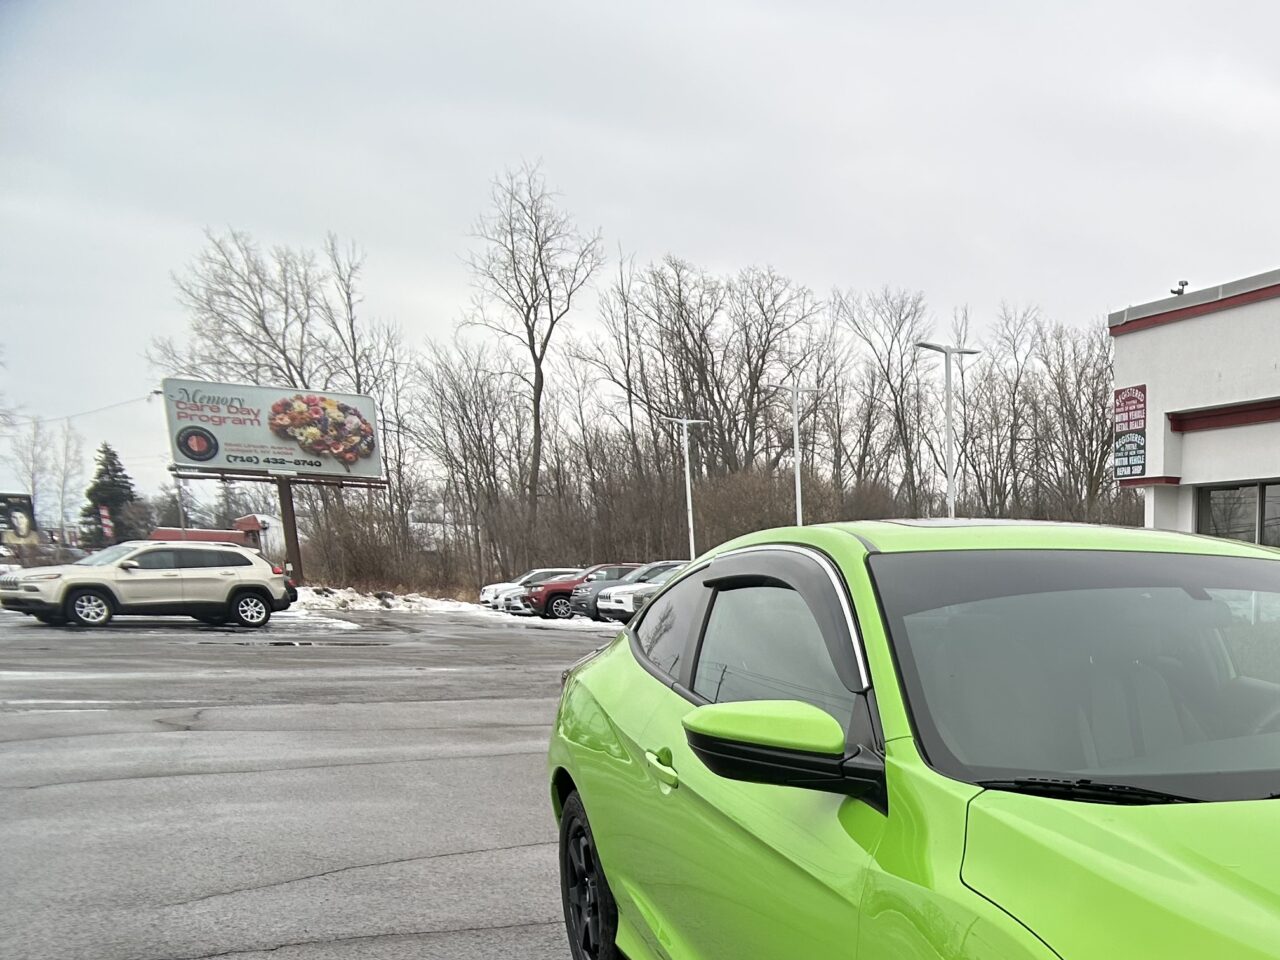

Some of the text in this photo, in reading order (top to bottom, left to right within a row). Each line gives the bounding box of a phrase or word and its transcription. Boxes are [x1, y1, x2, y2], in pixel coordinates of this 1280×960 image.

[167, 387, 245, 407] Memory
[175, 400, 261, 418] Care Day
[176, 411, 261, 426] Program
[226, 454, 260, 465] (716)
[262, 457, 322, 467] 432-8740
